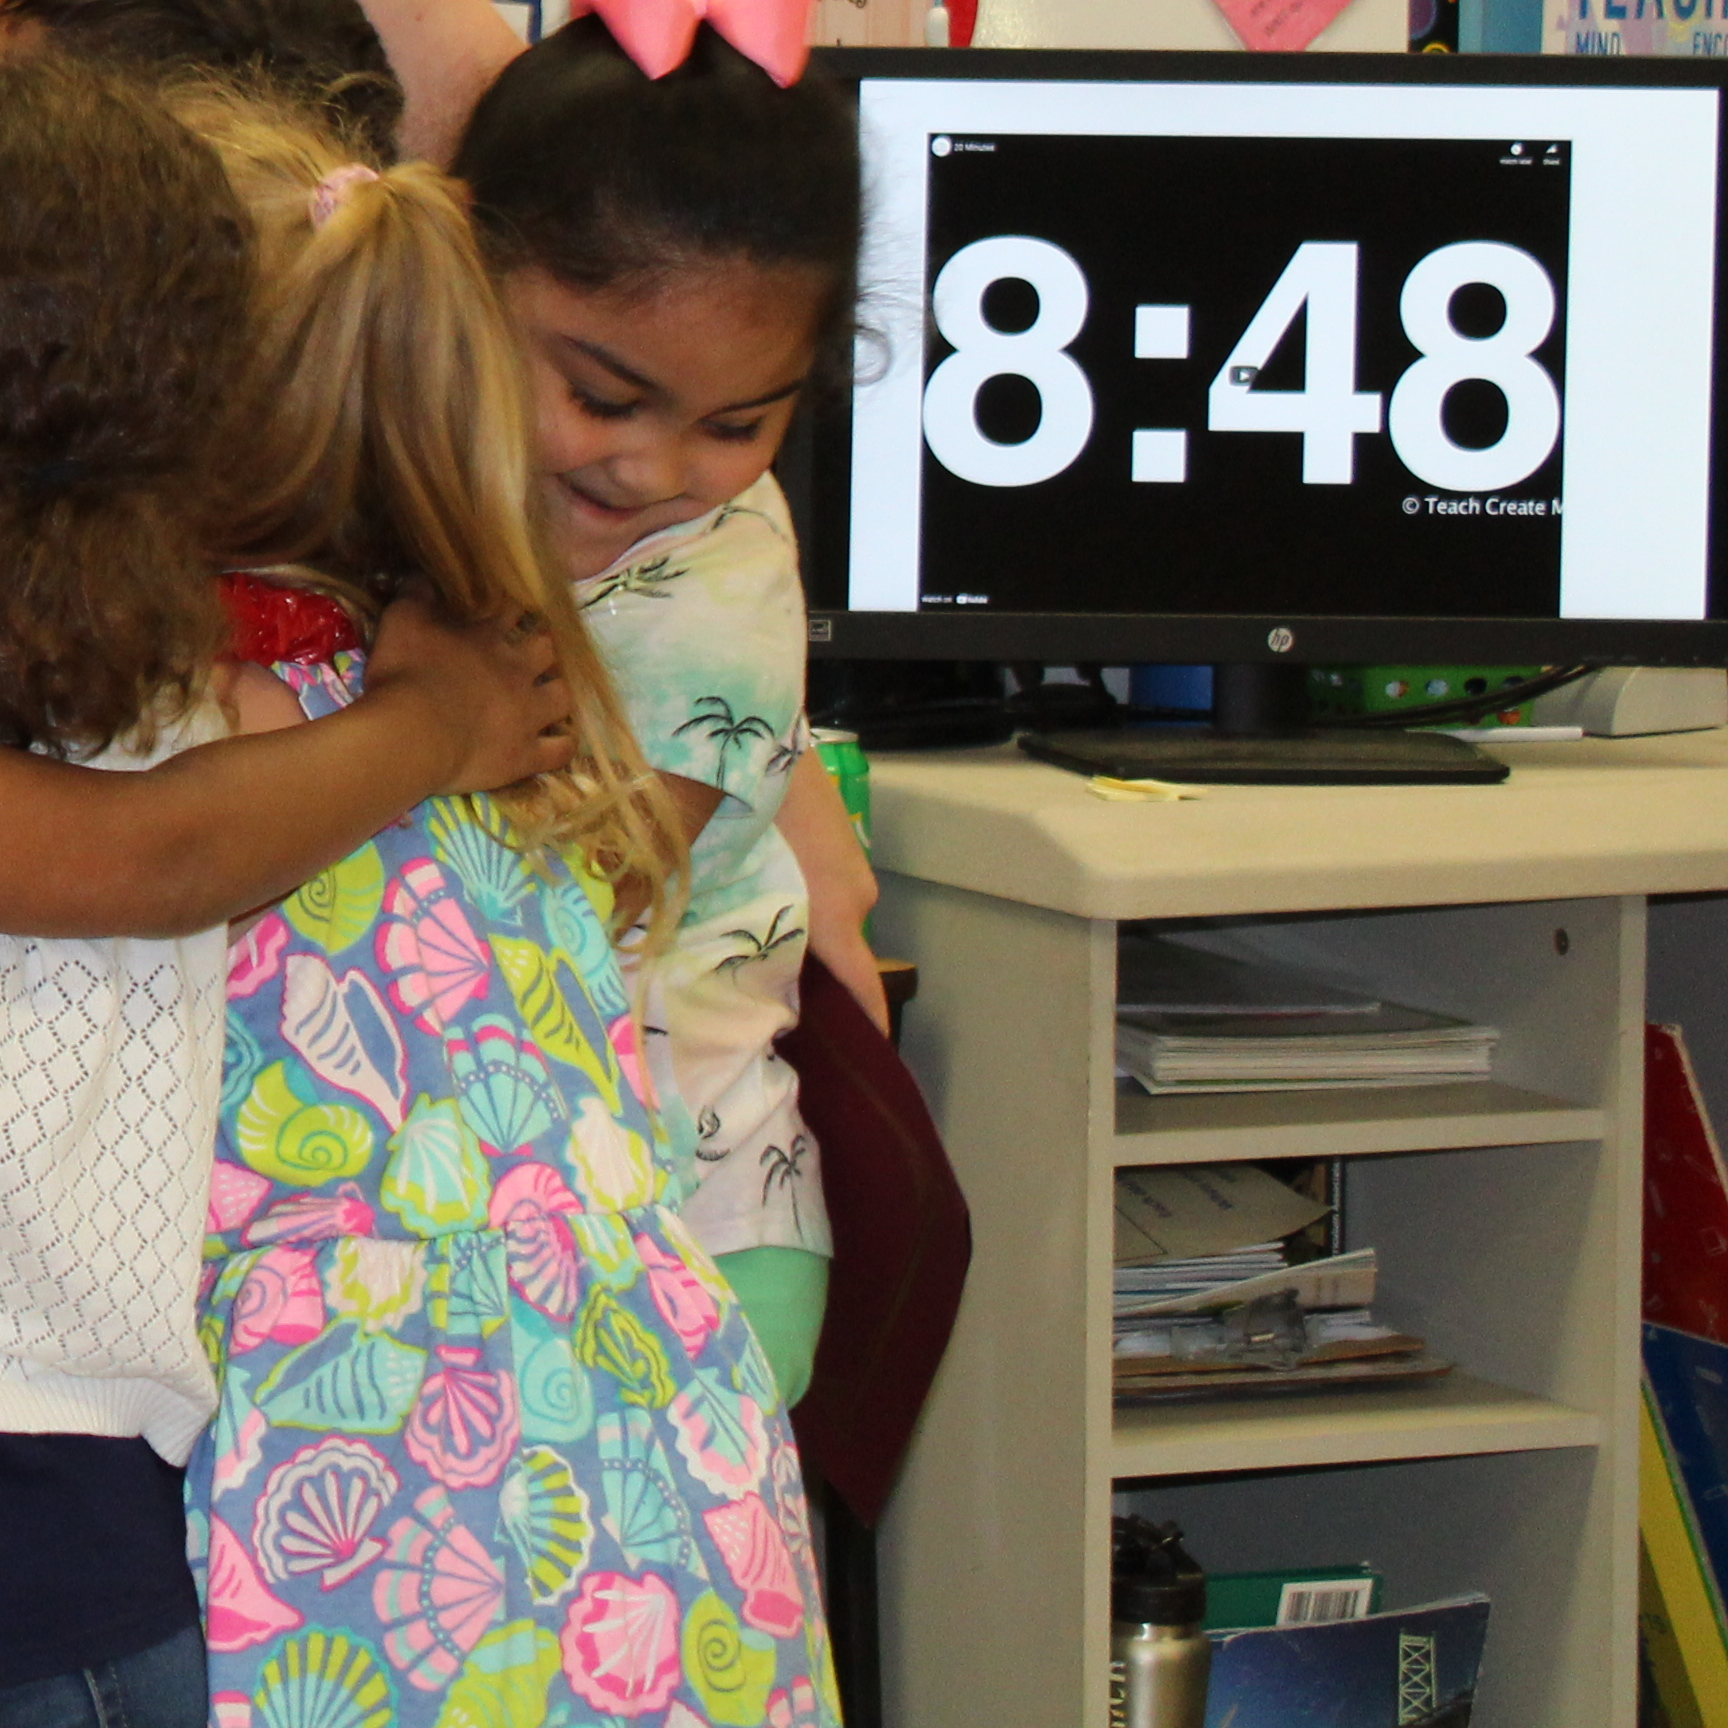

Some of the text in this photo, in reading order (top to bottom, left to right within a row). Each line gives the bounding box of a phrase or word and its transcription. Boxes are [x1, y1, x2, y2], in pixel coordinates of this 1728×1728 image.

[922, 234, 1560, 491] 8:48
[1425, 496, 1480, 514] Teach
[1486, 498, 1545, 515] Create
